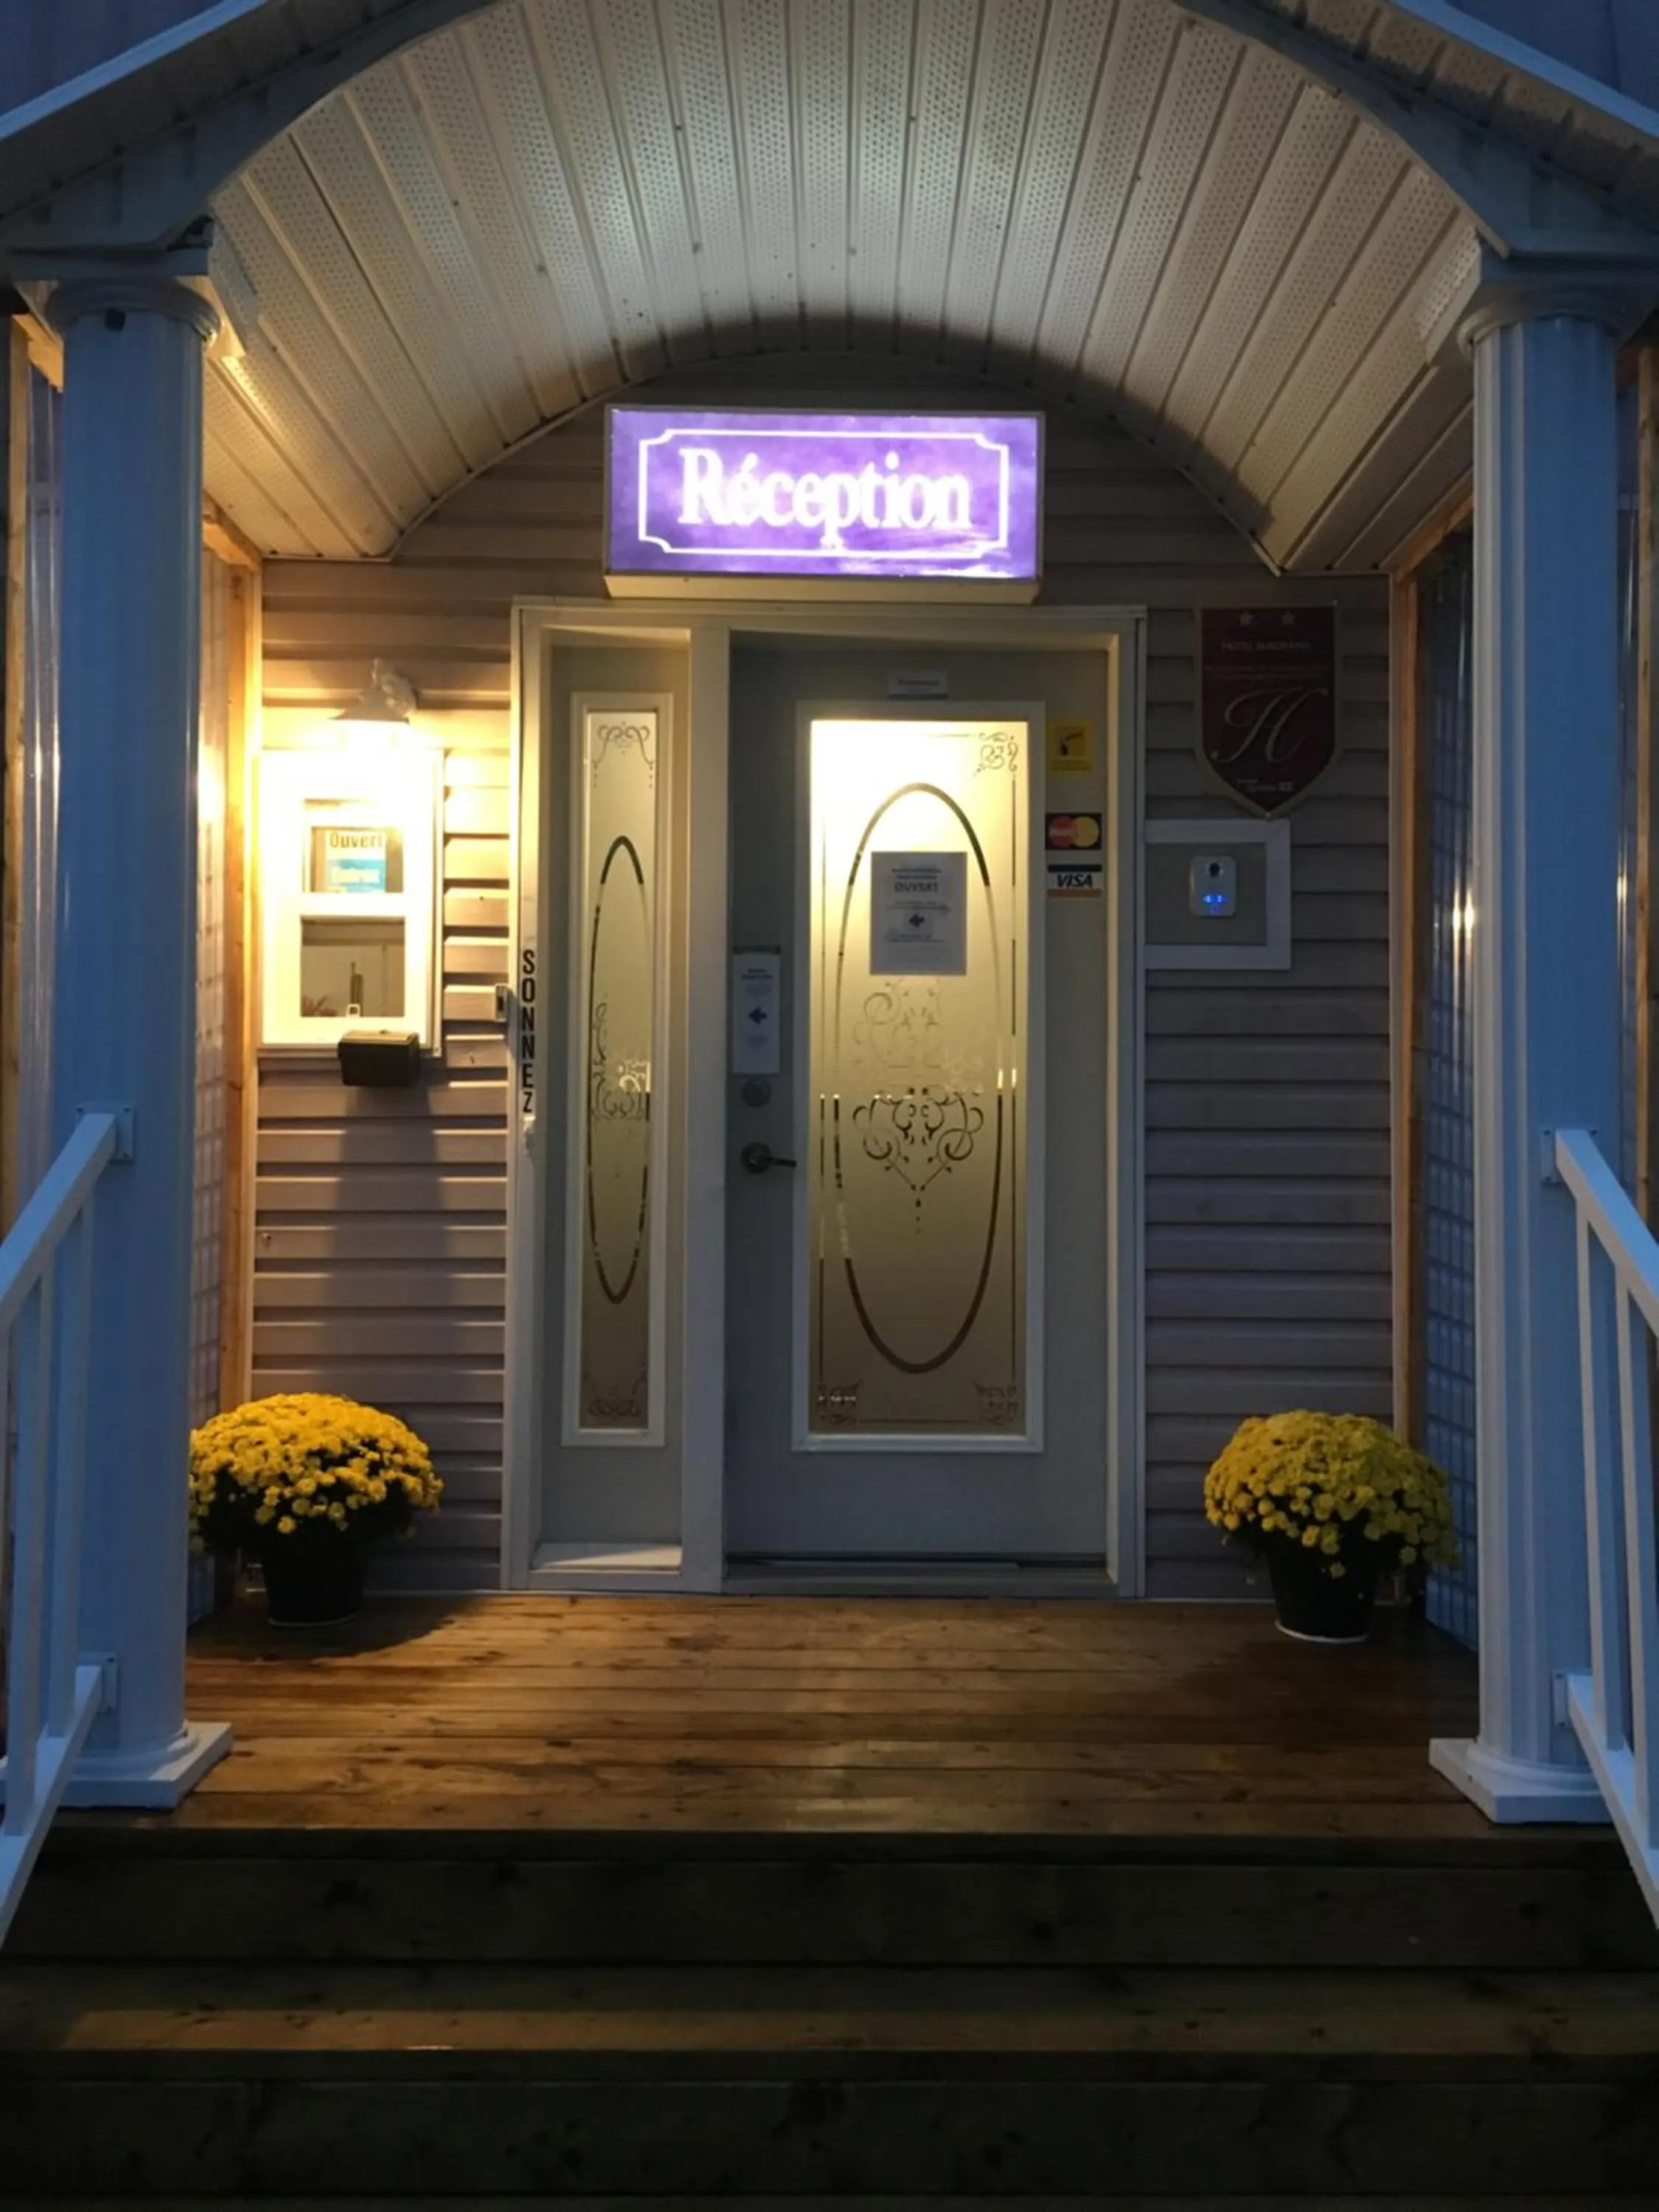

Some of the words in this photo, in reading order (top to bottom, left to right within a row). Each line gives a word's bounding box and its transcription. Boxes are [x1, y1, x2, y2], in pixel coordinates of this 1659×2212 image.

[678, 448, 972, 550] Réception
[1057, 874, 1093, 888] VISA
[522, 950, 535, 1112] SONNEZ
